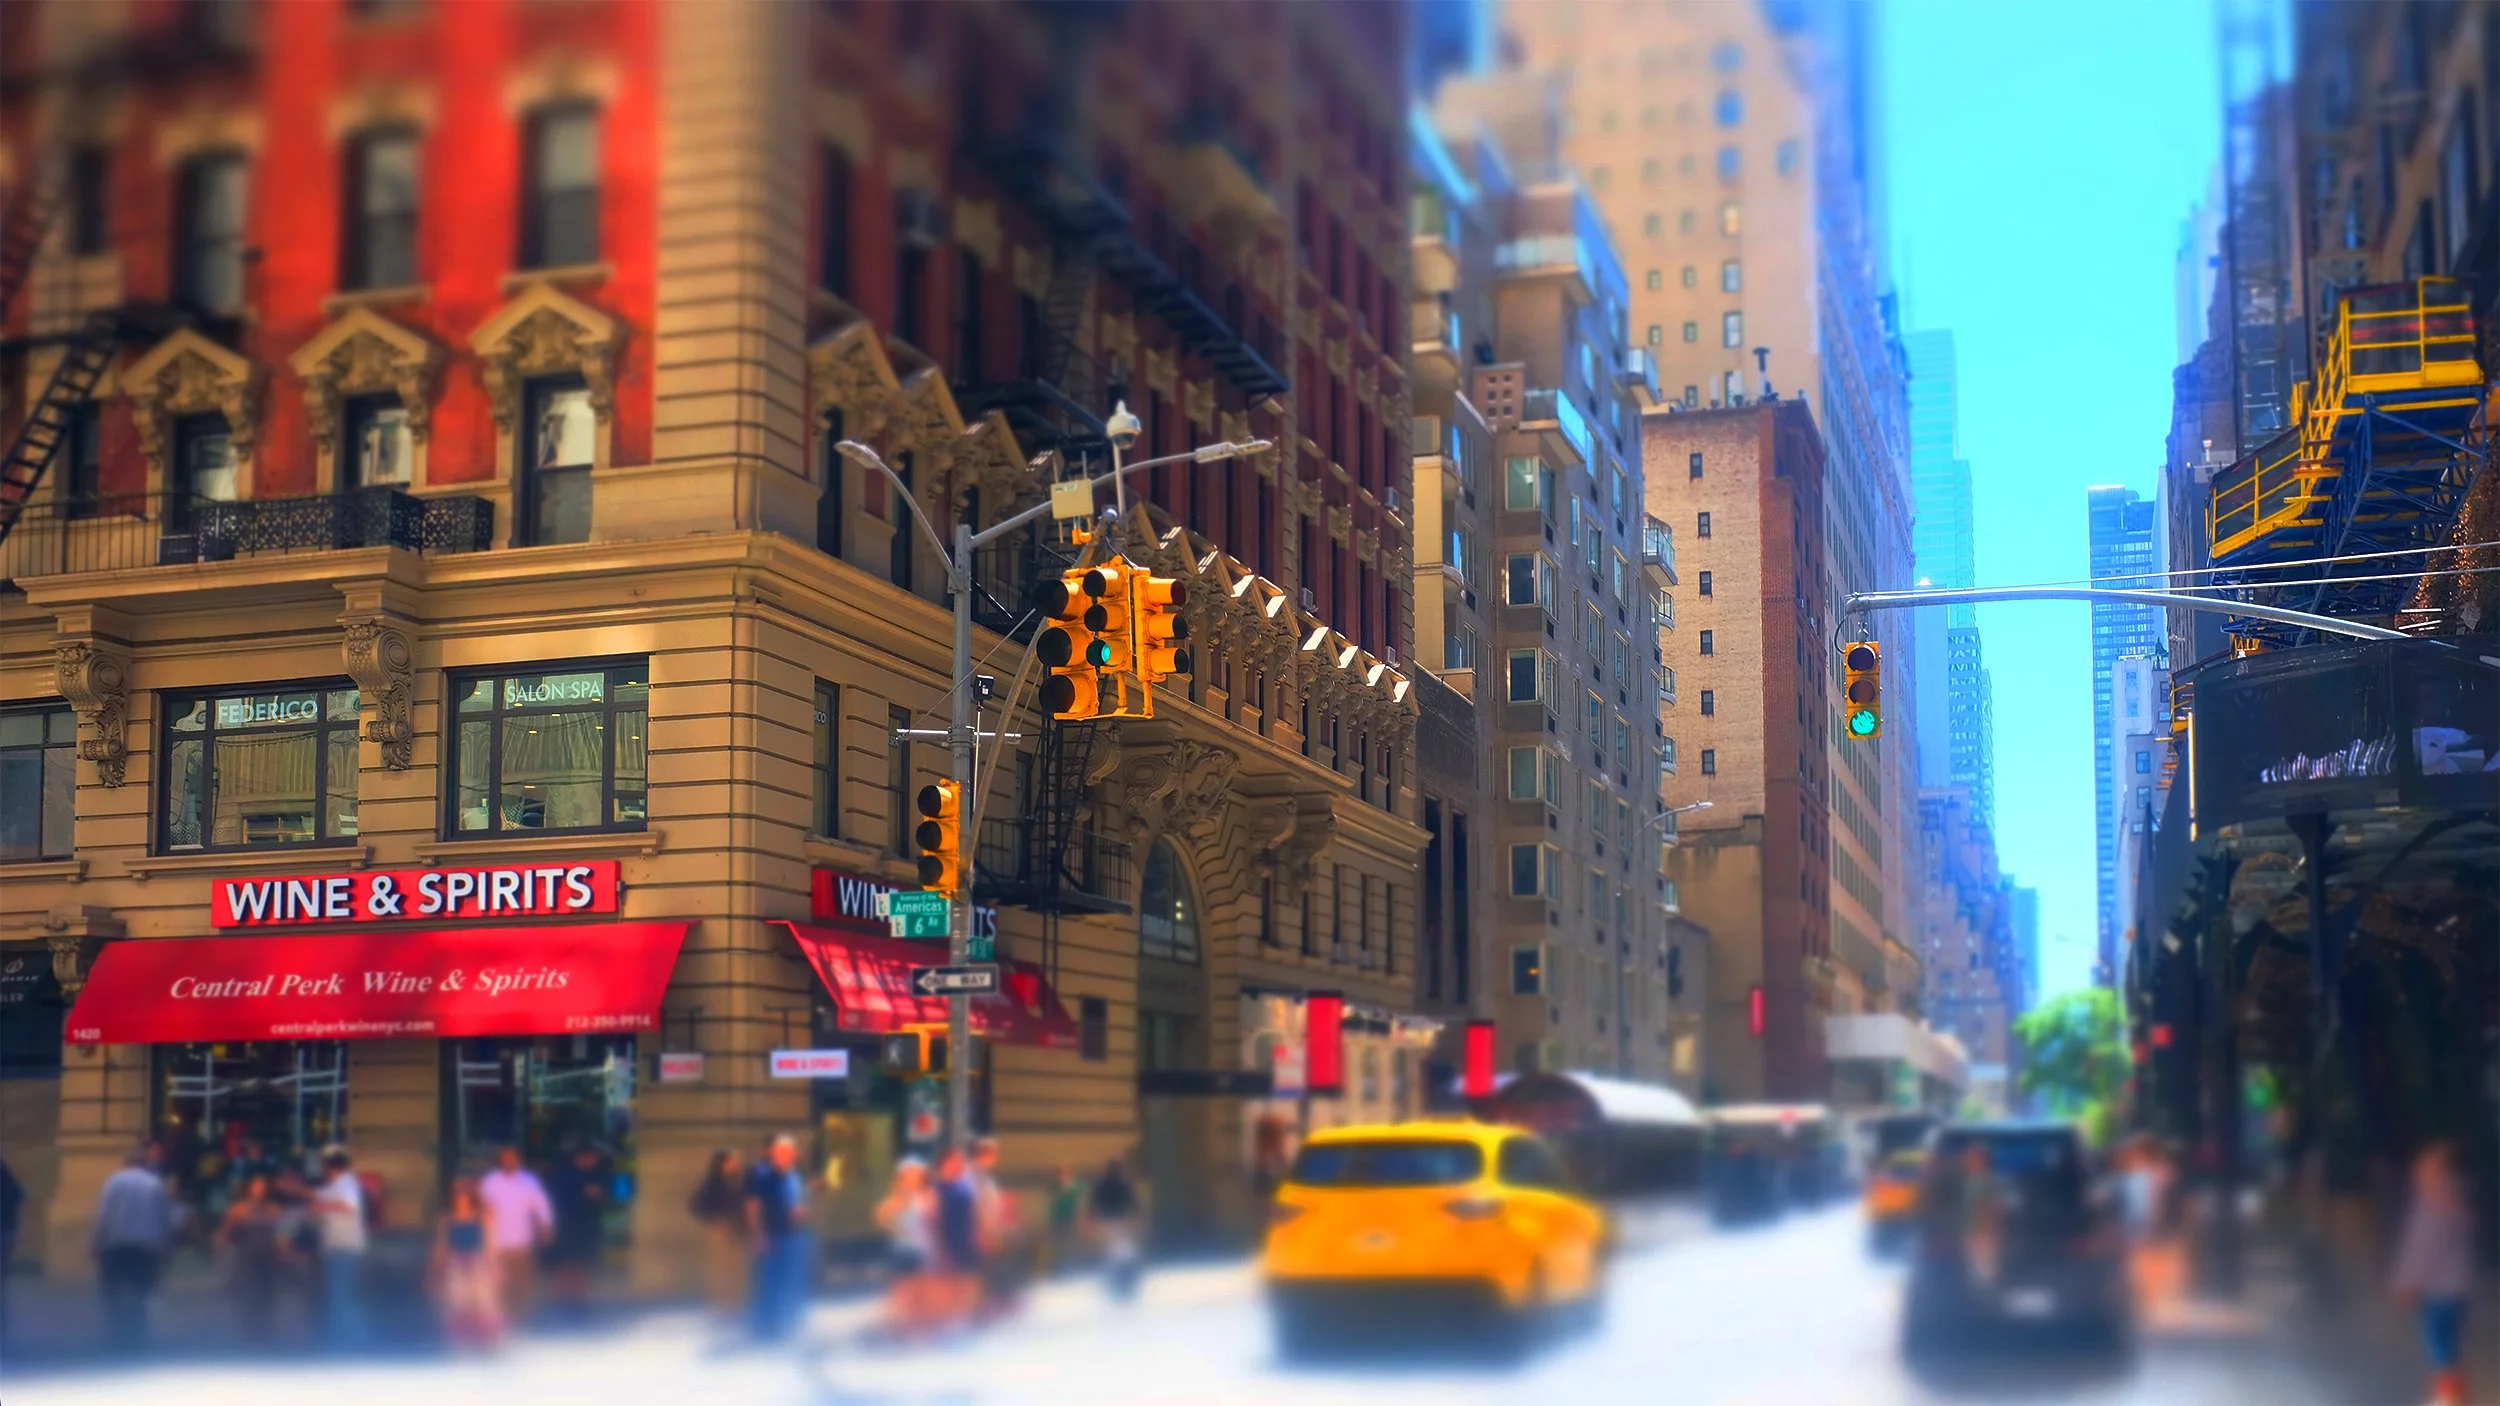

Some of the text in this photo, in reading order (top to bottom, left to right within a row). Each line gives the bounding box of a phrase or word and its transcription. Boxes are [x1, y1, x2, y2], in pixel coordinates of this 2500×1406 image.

[506, 680, 602, 703] SALON SPA
[219, 699, 318, 723] FEDERICO
[225, 866, 592, 920] WINE & SPIRITS
[838, 875, 900, 923] WIN
[895, 901, 943, 913] Americas
[914, 917, 924, 935] 6
[928, 916, 939, 927] Av
[170, 967, 570, 999] Central Perk Wine & Spirits
[924, 973, 988, 988] ONE WAY
[73, 1028, 101, 1040] 1420
